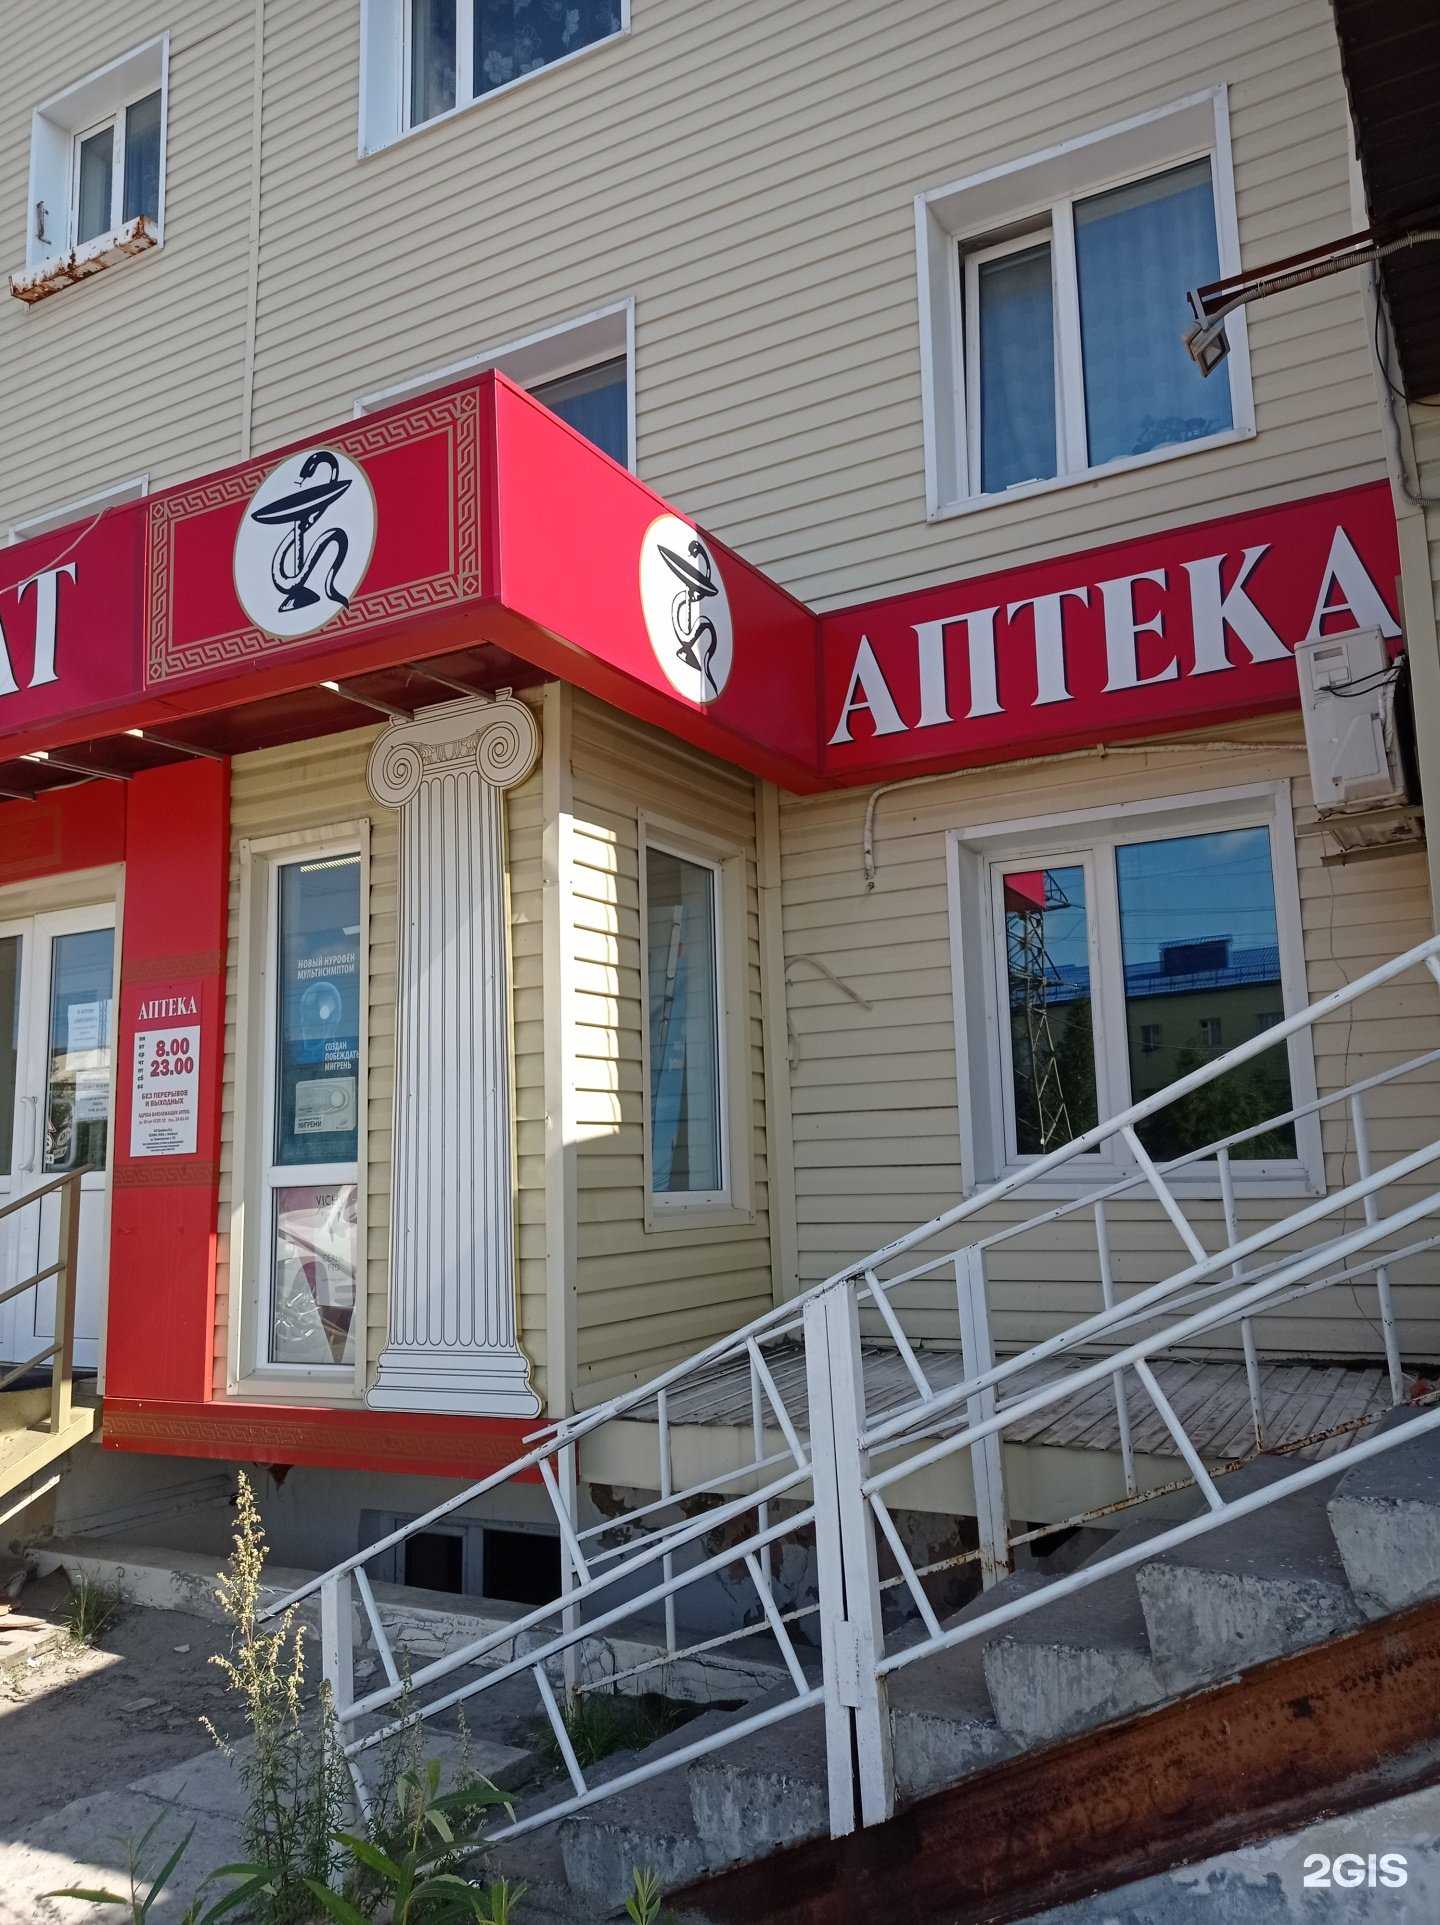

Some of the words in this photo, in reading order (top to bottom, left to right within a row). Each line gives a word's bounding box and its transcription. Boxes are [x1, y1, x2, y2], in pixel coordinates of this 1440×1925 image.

[826, 525, 1402, 746] АПТЕКА
[298, 958, 322, 969] НОВЫЙ
[324, 953, 355, 965] НУРОФЕН
[297, 964, 354, 980] МУЛЬТИСИМПТОМ
[138, 996, 198, 1020] АПТЕКА
[156, 1037, 190, 1057] 8.00
[325, 1041, 347, 1052] СОЗДАН
[150, 1056, 194, 1077] 23.00
[325, 1061, 352, 1072] МИГРЕНЬ
